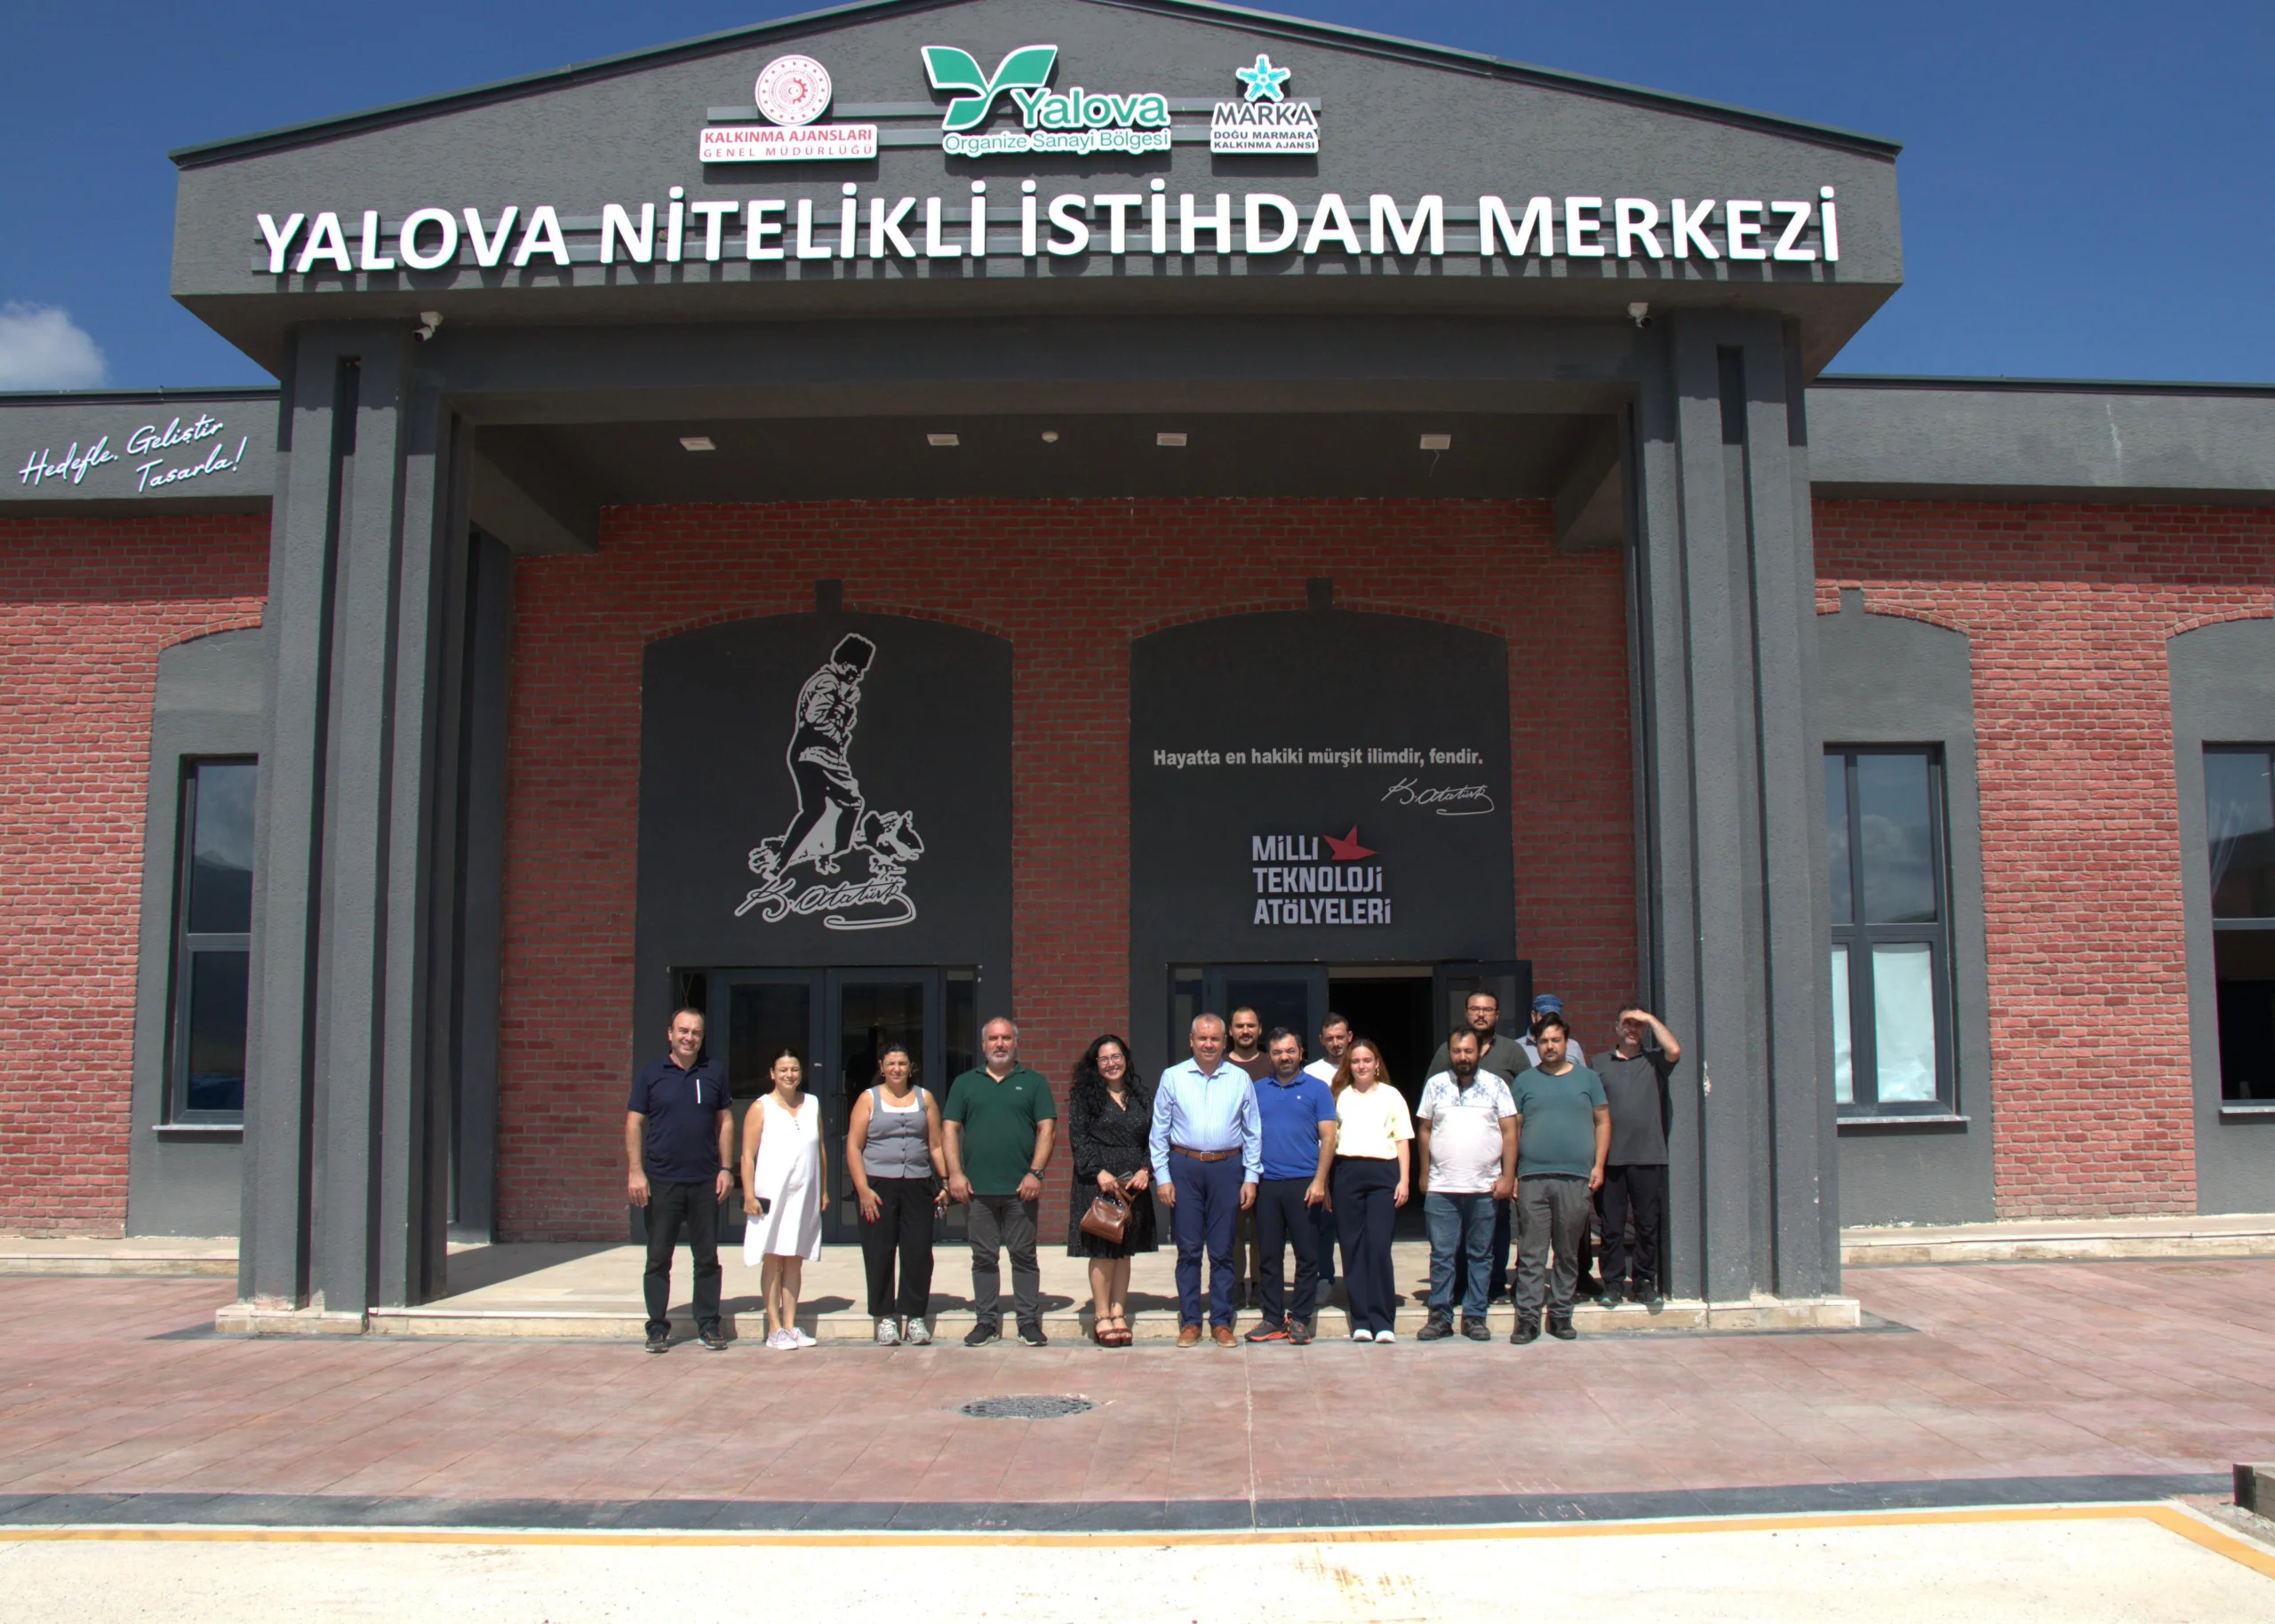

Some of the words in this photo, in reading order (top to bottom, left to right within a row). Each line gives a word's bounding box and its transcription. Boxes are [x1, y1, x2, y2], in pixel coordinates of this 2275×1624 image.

[1012, 90, 1168, 125] Yalova
[1214, 105, 1313, 126] MARKA
[705, 131, 785, 144] KALKINMA
[789, 128, 872, 141] AJANSLARI
[945, 132, 1027, 154] Organize
[1033, 131, 1095, 151] Sanayi
[1100, 130, 1169, 150] Bölgesi
[1214, 130, 1249, 139] DOĞU
[1252, 131, 1313, 139] MARMARA
[1275, 140, 1315, 149] AJANSI
[703, 147, 755, 158] GENEL
[765, 144, 873, 157] MÜDÜRLÜĞÜ
[257, 205, 570, 273] YALOVA
[600, 180, 986, 263] NİTELİKLİ
[1021, 178, 1444, 257] İSTİHDAM
[1479, 186, 1839, 262] MERKEZİ
[126, 413, 223, 455] Geliştir
[136, 436, 247, 492] Tasarla!
[1153, 749, 1220, 769] Hayatta
[1225, 752, 1246, 765] en
[1251, 747, 1303, 764] hakiki
[1308, 747, 1363, 768] mürşit
[1368, 747, 1425, 768] ilimdir,
[1429, 747, 1483, 765] fendir.
[1252, 866, 1382, 893] TEKNOLOJİ
[1253, 898, 1391, 925] ATÖLYELERİ
